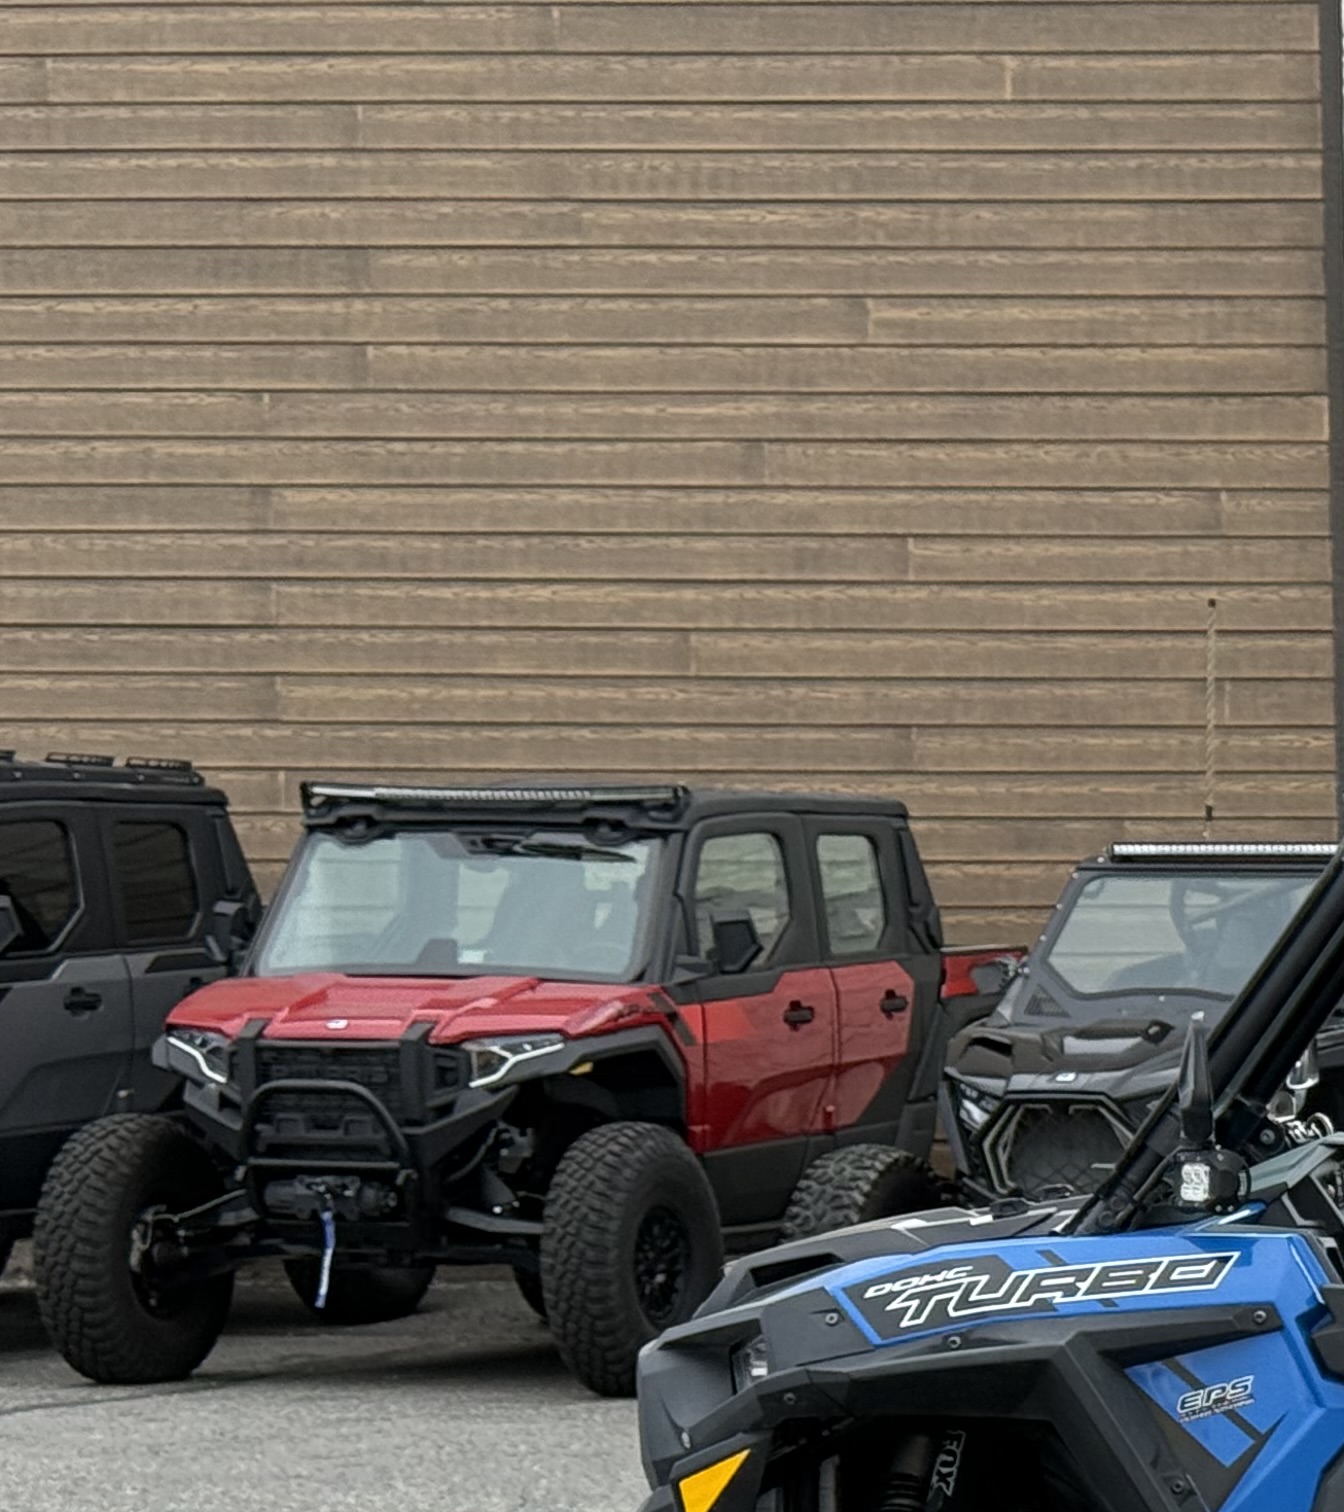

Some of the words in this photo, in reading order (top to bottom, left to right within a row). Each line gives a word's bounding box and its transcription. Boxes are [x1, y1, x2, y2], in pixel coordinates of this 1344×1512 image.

[863, 1266, 974, 1299] DOHC
[885, 1251, 1242, 1328] TURBO
[1176, 1374, 1256, 1414] EPS
[928, 1429, 967, 1498] FOX
